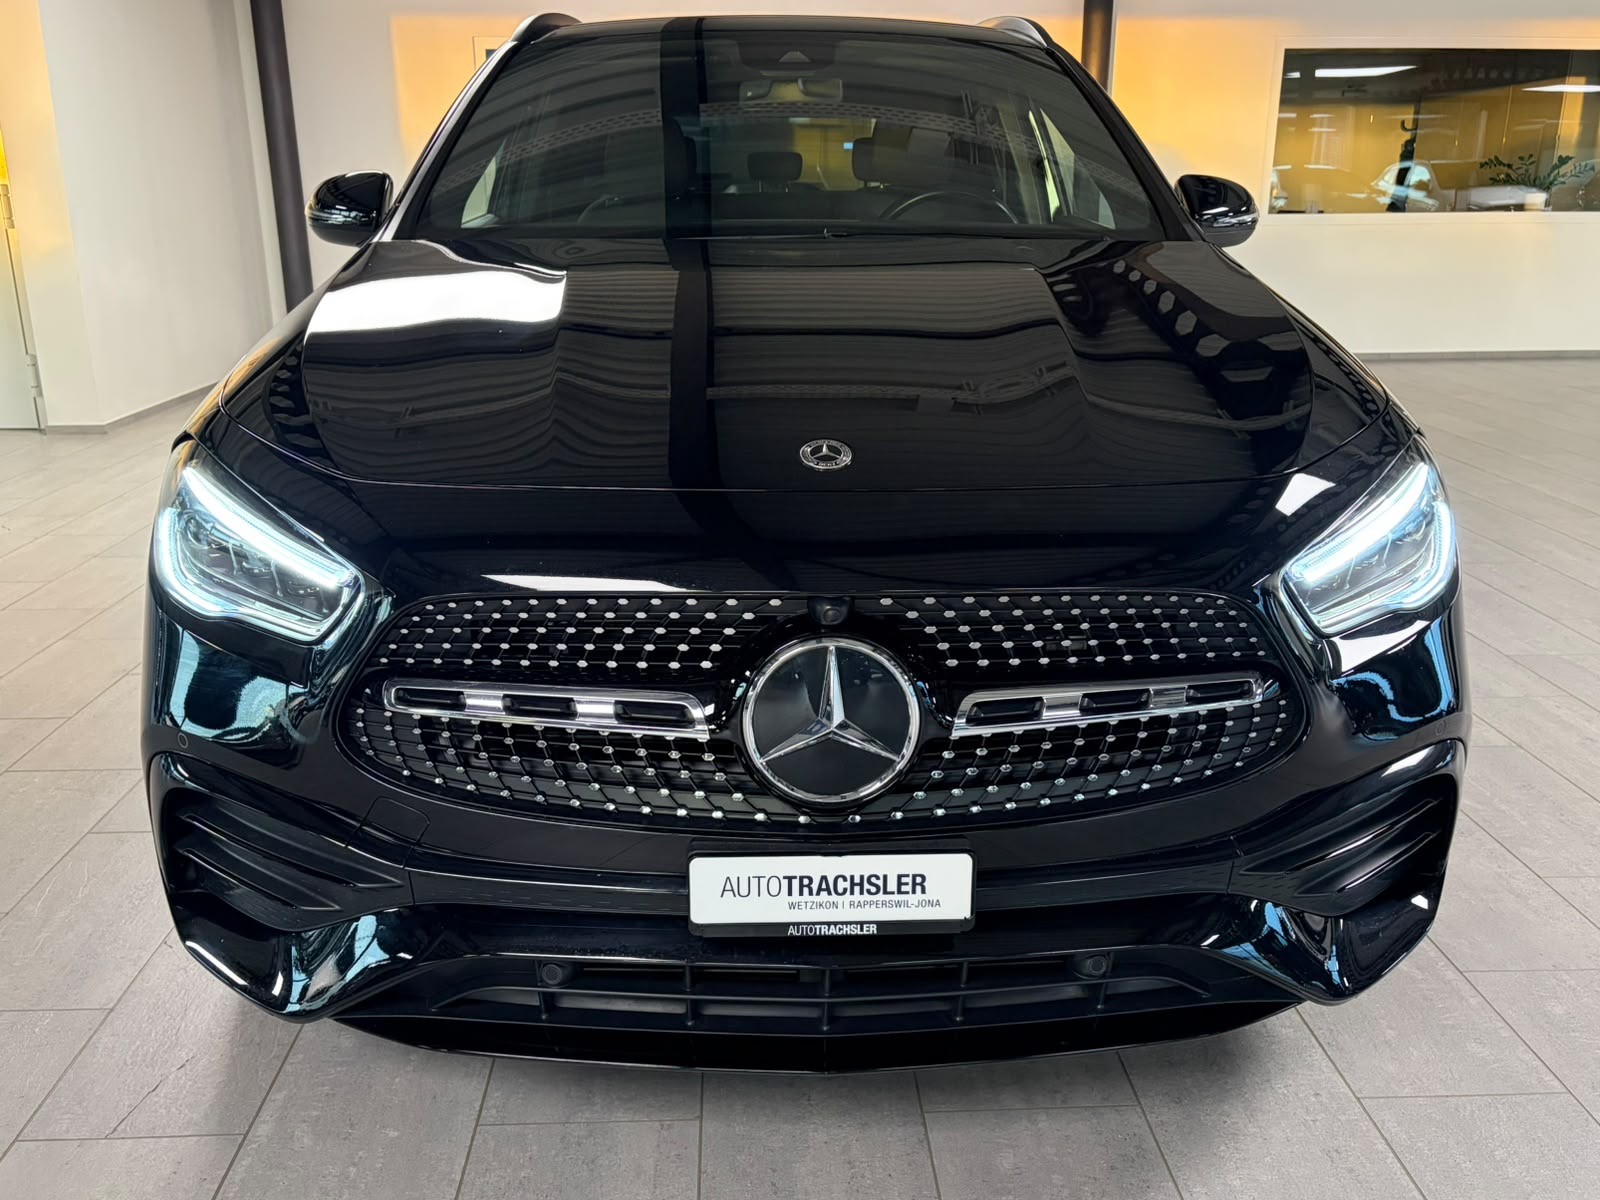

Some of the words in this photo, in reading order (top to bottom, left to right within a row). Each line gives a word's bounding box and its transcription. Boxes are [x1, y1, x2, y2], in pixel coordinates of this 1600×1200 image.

[720, 873, 928, 898] AUTOTRACHSLER
[787, 901, 839, 910] WETZIKON
[849, 898, 942, 909] RAPPERSWIL-JONA
[787, 924, 878, 936] AUTOTRACHSLER
